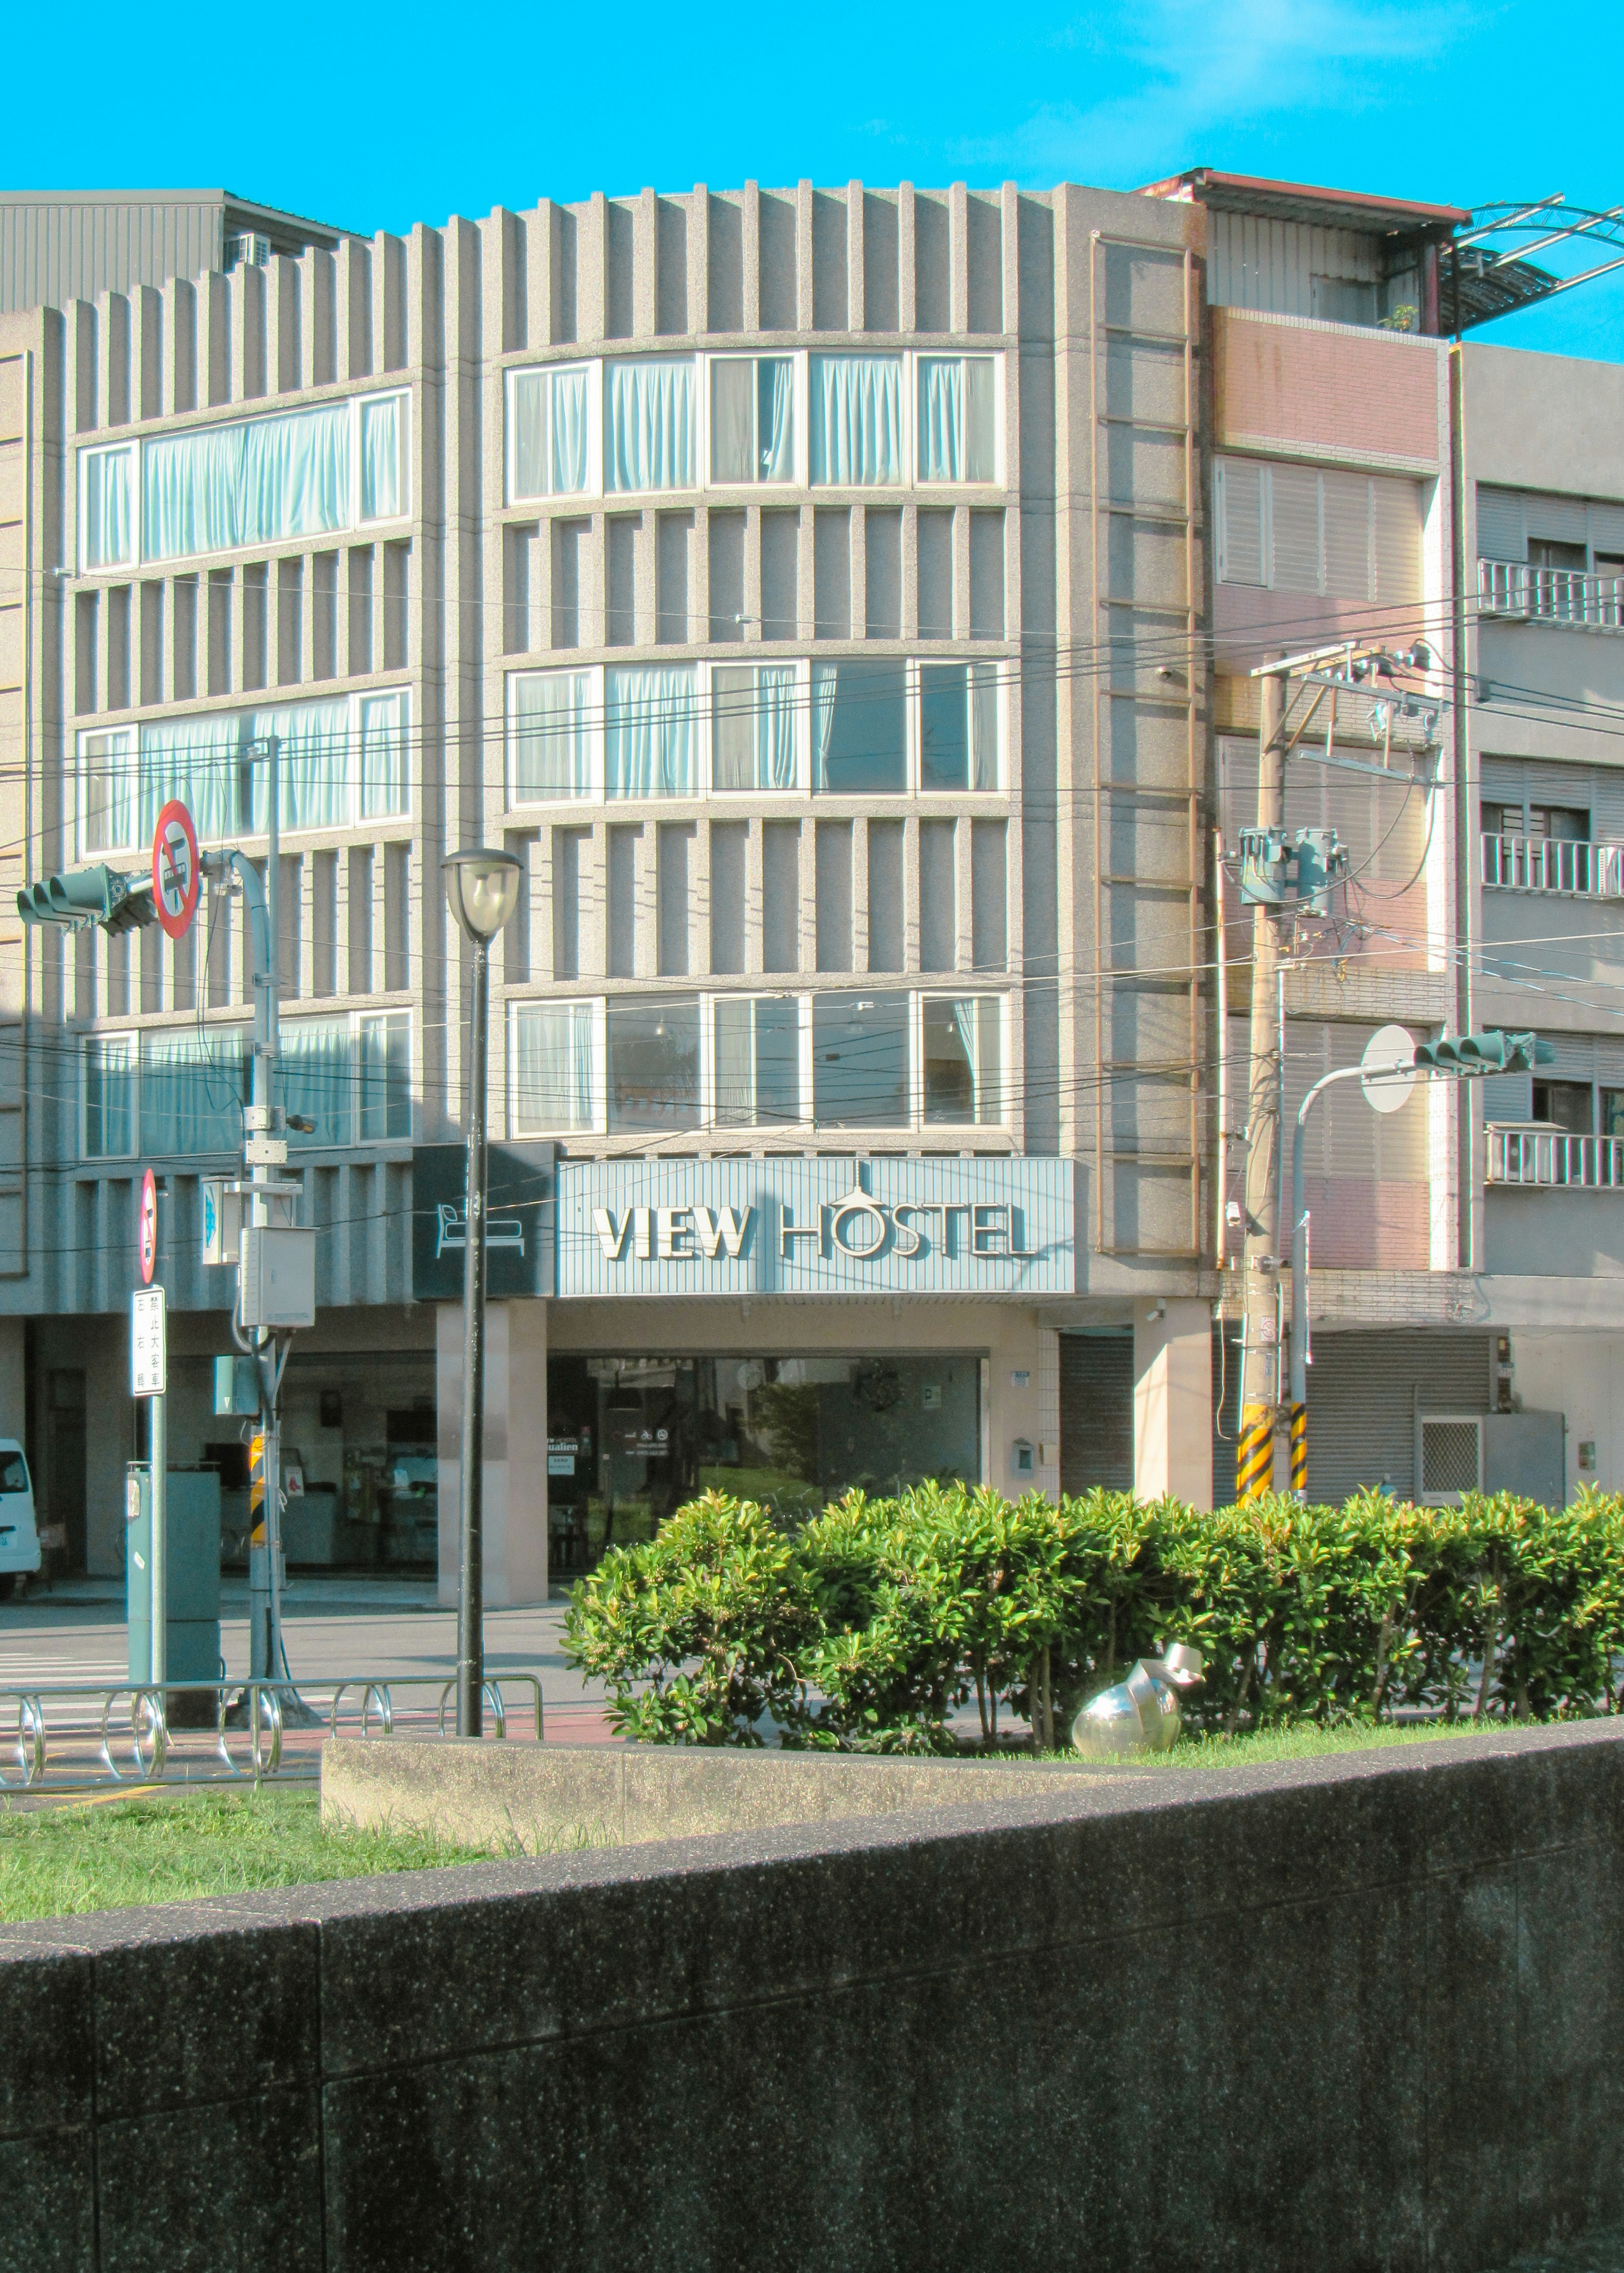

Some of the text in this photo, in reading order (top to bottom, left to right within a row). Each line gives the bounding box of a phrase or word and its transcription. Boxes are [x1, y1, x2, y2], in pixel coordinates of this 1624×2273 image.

[592, 1202, 1037, 1260] VIEW HOSTEL
[150, 1296, 160, 1387] 禁止大客車
[548, 1442, 578, 1451] ualien
